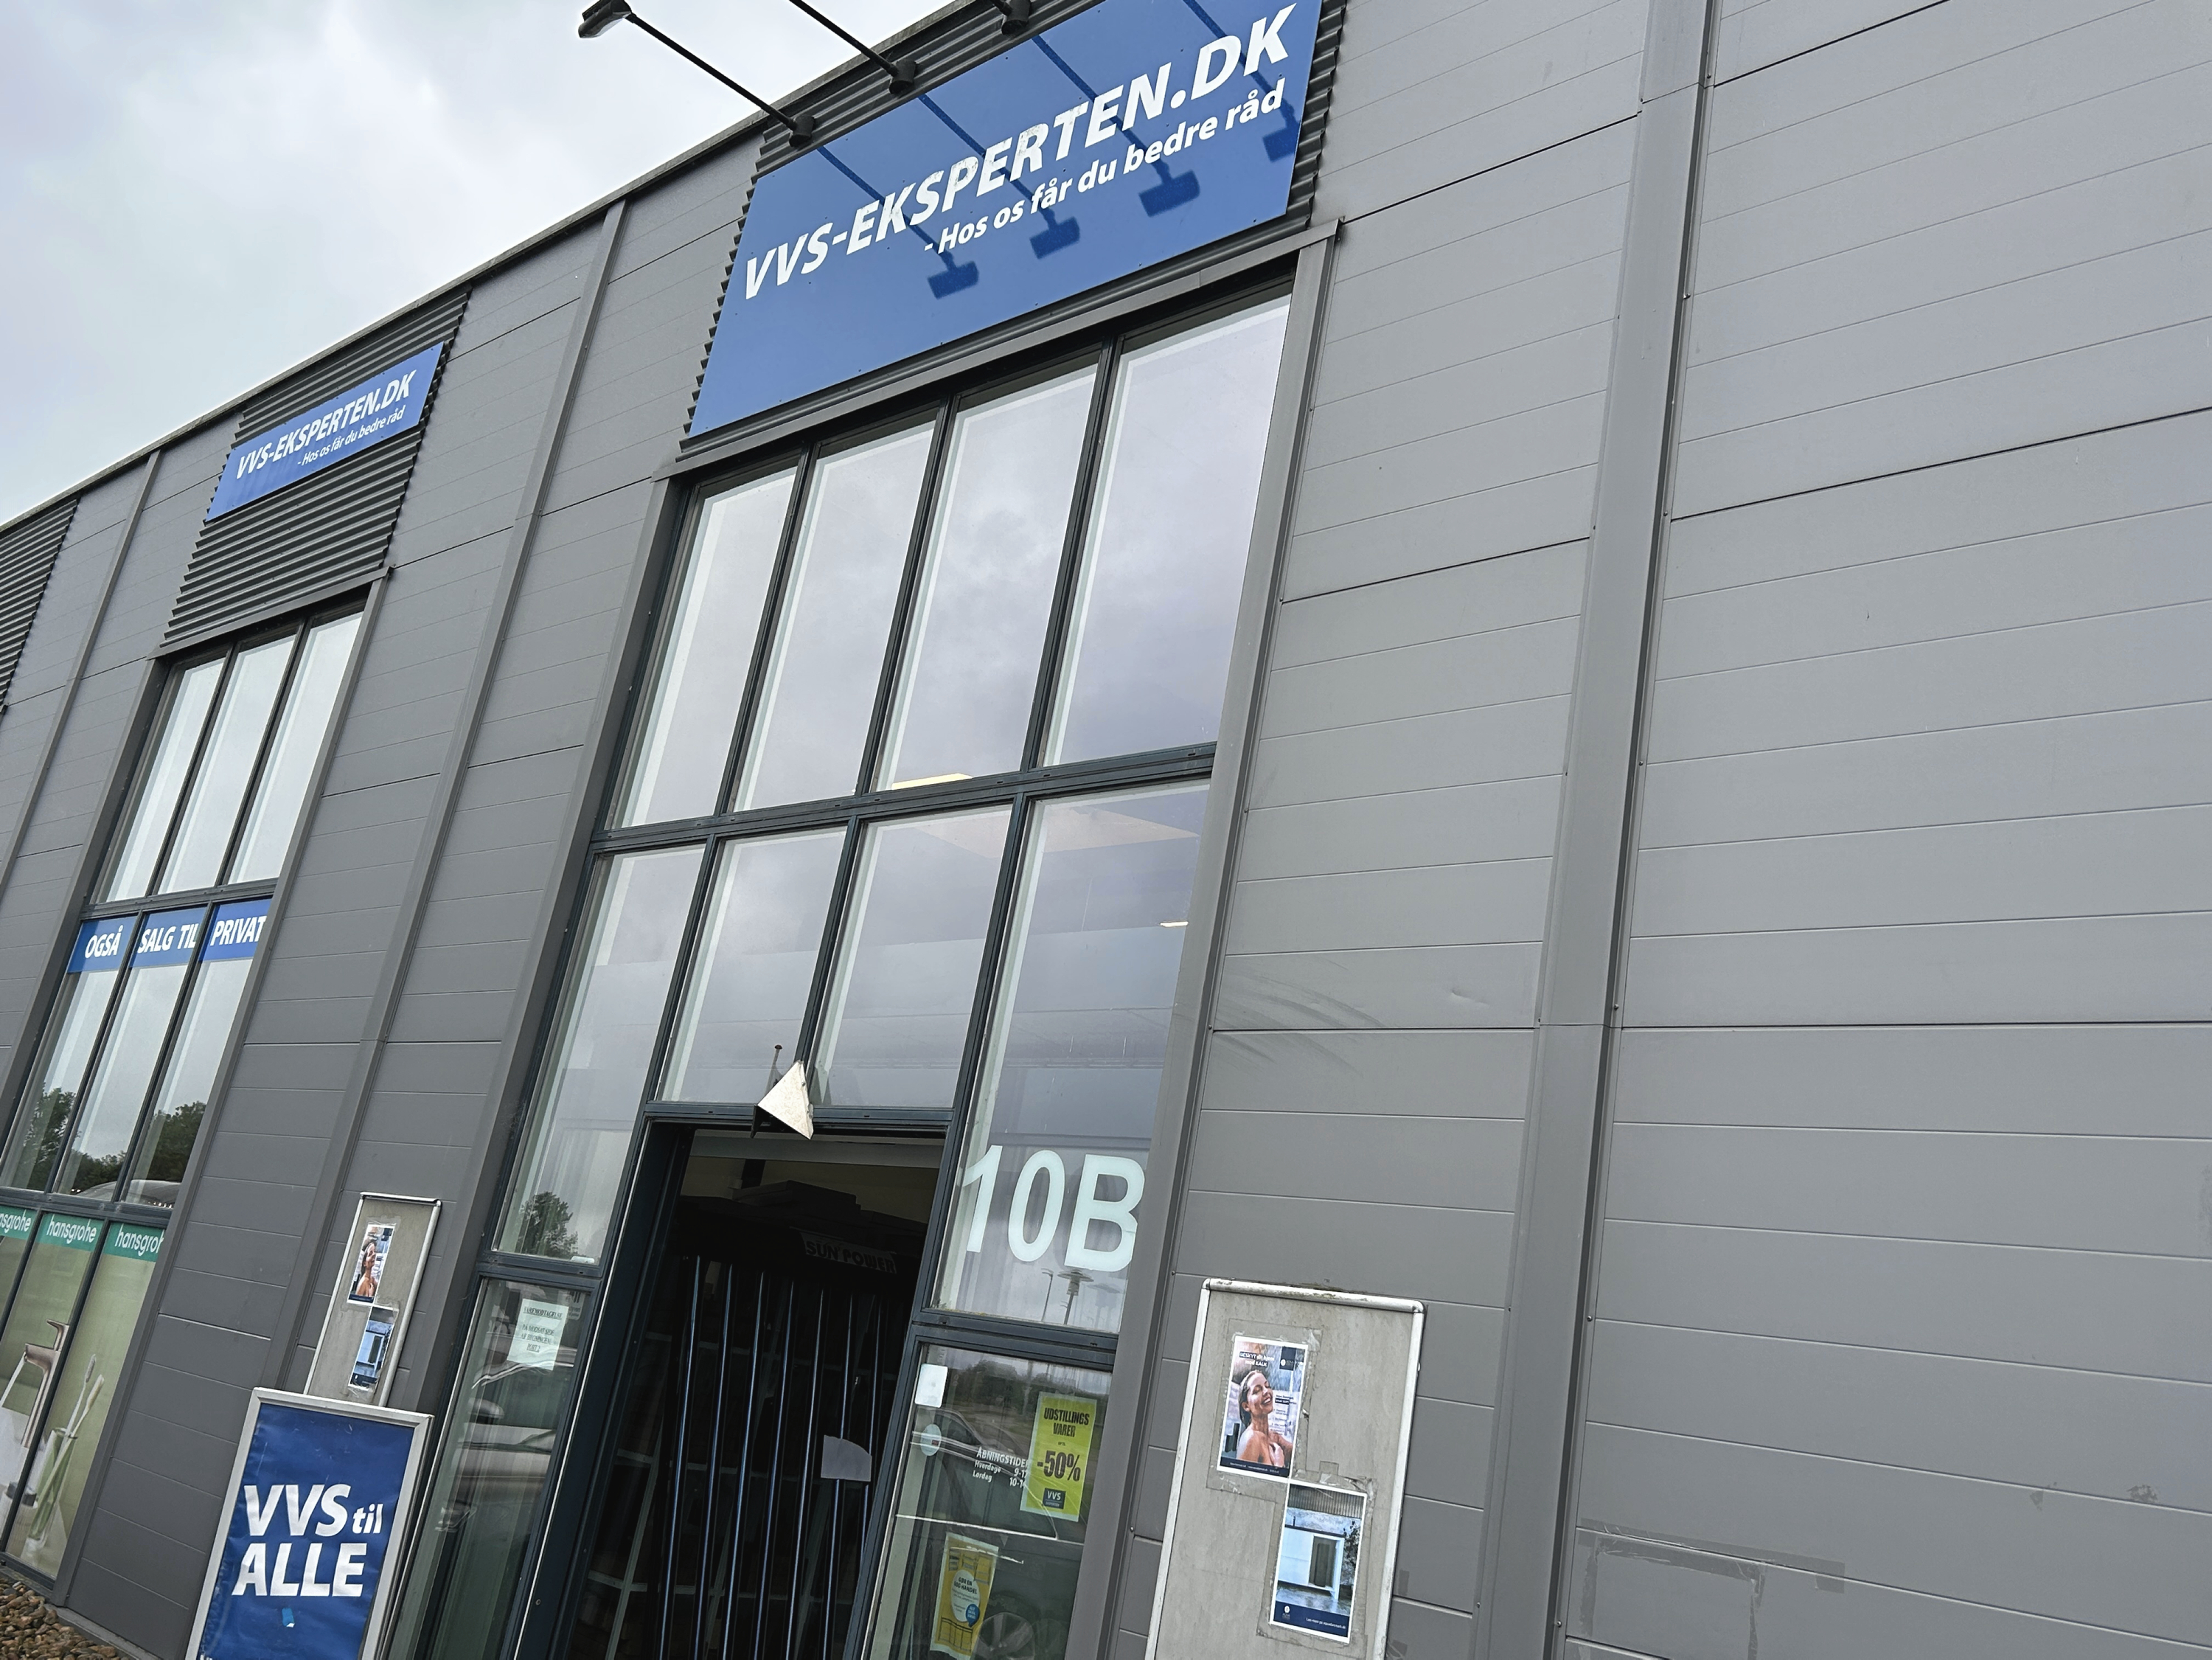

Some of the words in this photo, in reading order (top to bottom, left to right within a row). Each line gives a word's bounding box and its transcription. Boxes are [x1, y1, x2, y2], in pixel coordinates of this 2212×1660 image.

[745, 2, 1298, 300] VVS-EKSPERTEN.DK
[938, 216, 988, 254] Hos
[993, 199, 1026, 229] os
[1030, 177, 1073, 214] får
[1077, 159, 1118, 193] du
[1123, 117, 1218, 175] bedre
[1225, 77, 1286, 131] råd
[236, 369, 417, 479] VVS-EKSPERTEN.DK
[302, 447, 319, 467] Hos
[319, 443, 331, 457] os
[331, 436, 344, 454] får
[344, 428, 357, 444] du
[358, 416, 385, 438] bedre
[386, 405, 406, 426] råd
[85, 925, 124, 958] OGSÅ
[138, 926, 176, 954] SALG
[177, 923, 199, 950] TIL
[210, 915, 268, 947] PRIVAT
[957, 1145, 1145, 1272] 10B
[46, 1214, 97, 1244] hansgrohe
[806, 1240, 839, 1260] SUN
[842, 1249, 895, 1273] POWER
[1044, 1407, 1090, 1425] UDSTILLINGS
[1053, 1423, 1077, 1437] VARER
[1037, 1450, 1081, 1482] -50%
[243, 1484, 352, 1537] VVS
[352, 1504, 383, 1534] til
[1047, 1490, 1062, 1501] VVS
[232, 1543, 367, 1597] ALLE
[961, 1584, 978, 1594] HANDEL
